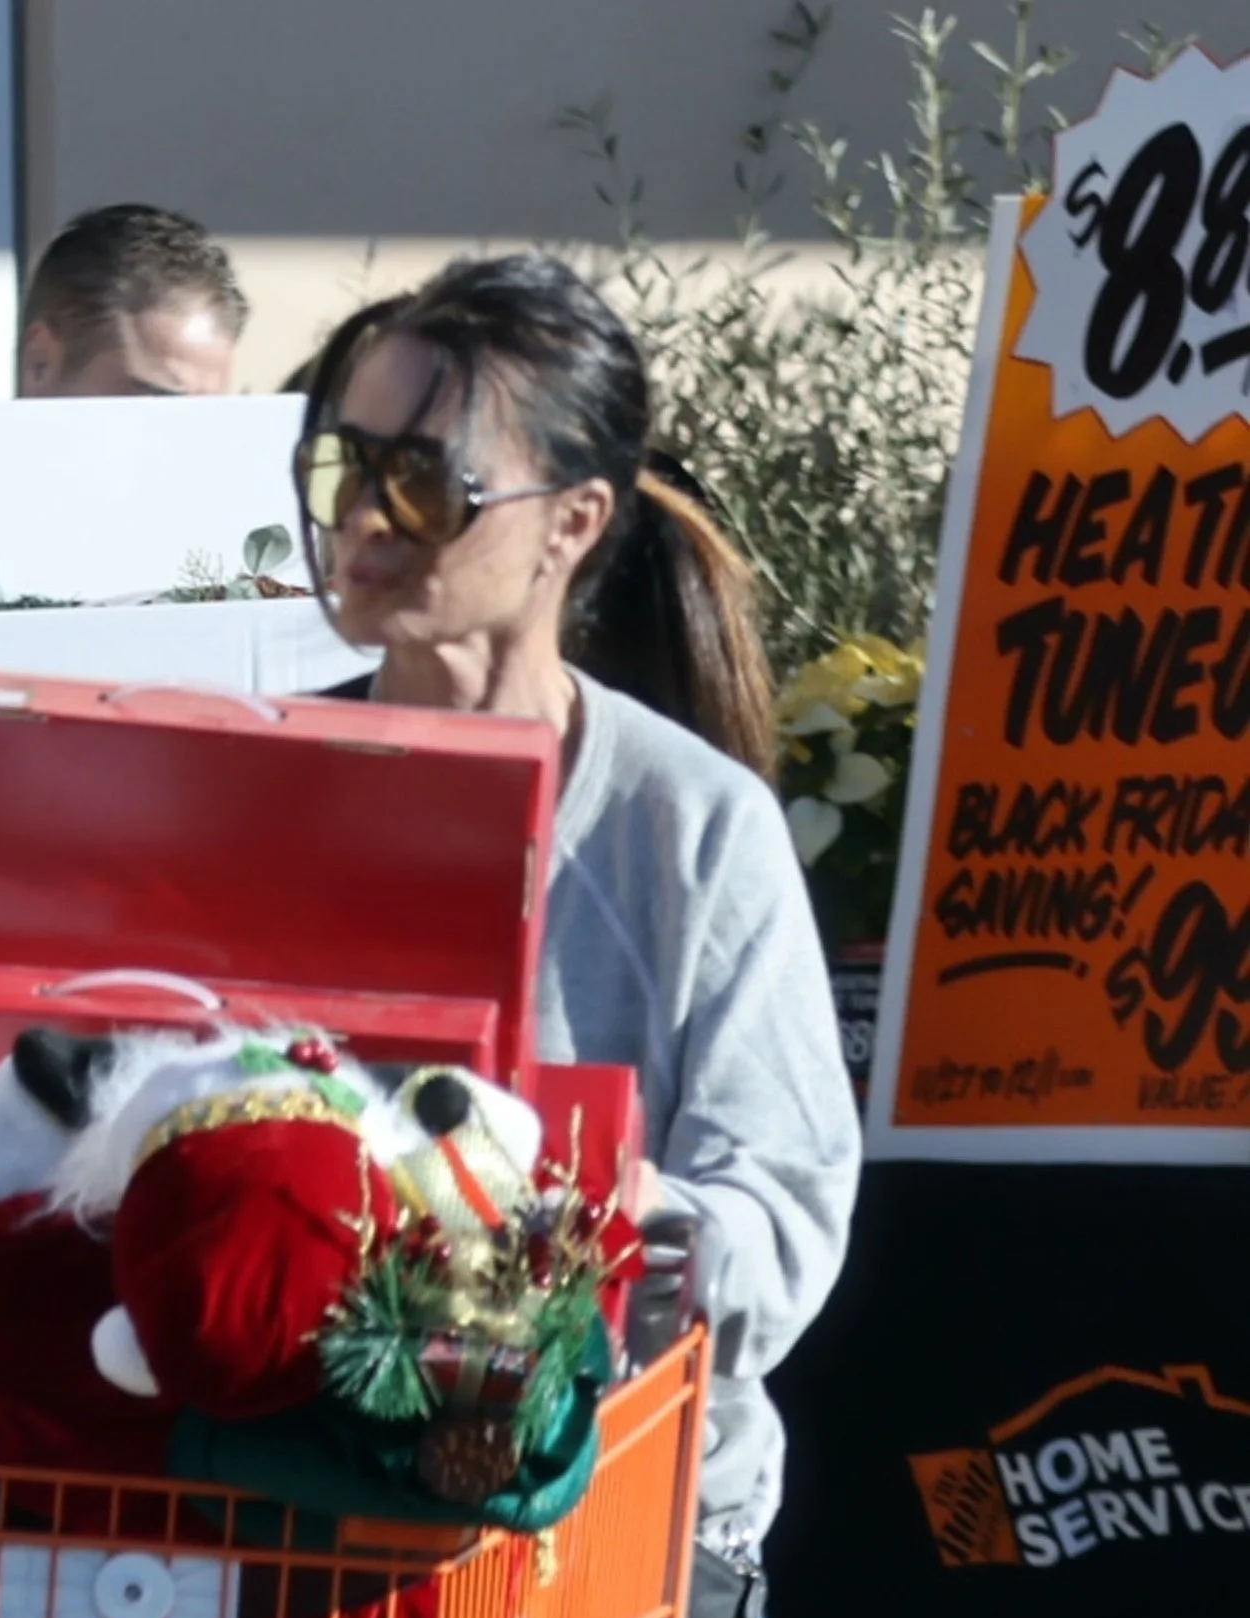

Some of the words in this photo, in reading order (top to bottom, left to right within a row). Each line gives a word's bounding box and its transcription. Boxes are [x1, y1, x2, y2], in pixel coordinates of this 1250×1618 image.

[996, 462, 1250, 589] HEATI
[947, 779, 1102, 860] BLACK
[995, 1427, 1181, 1506] HOME
